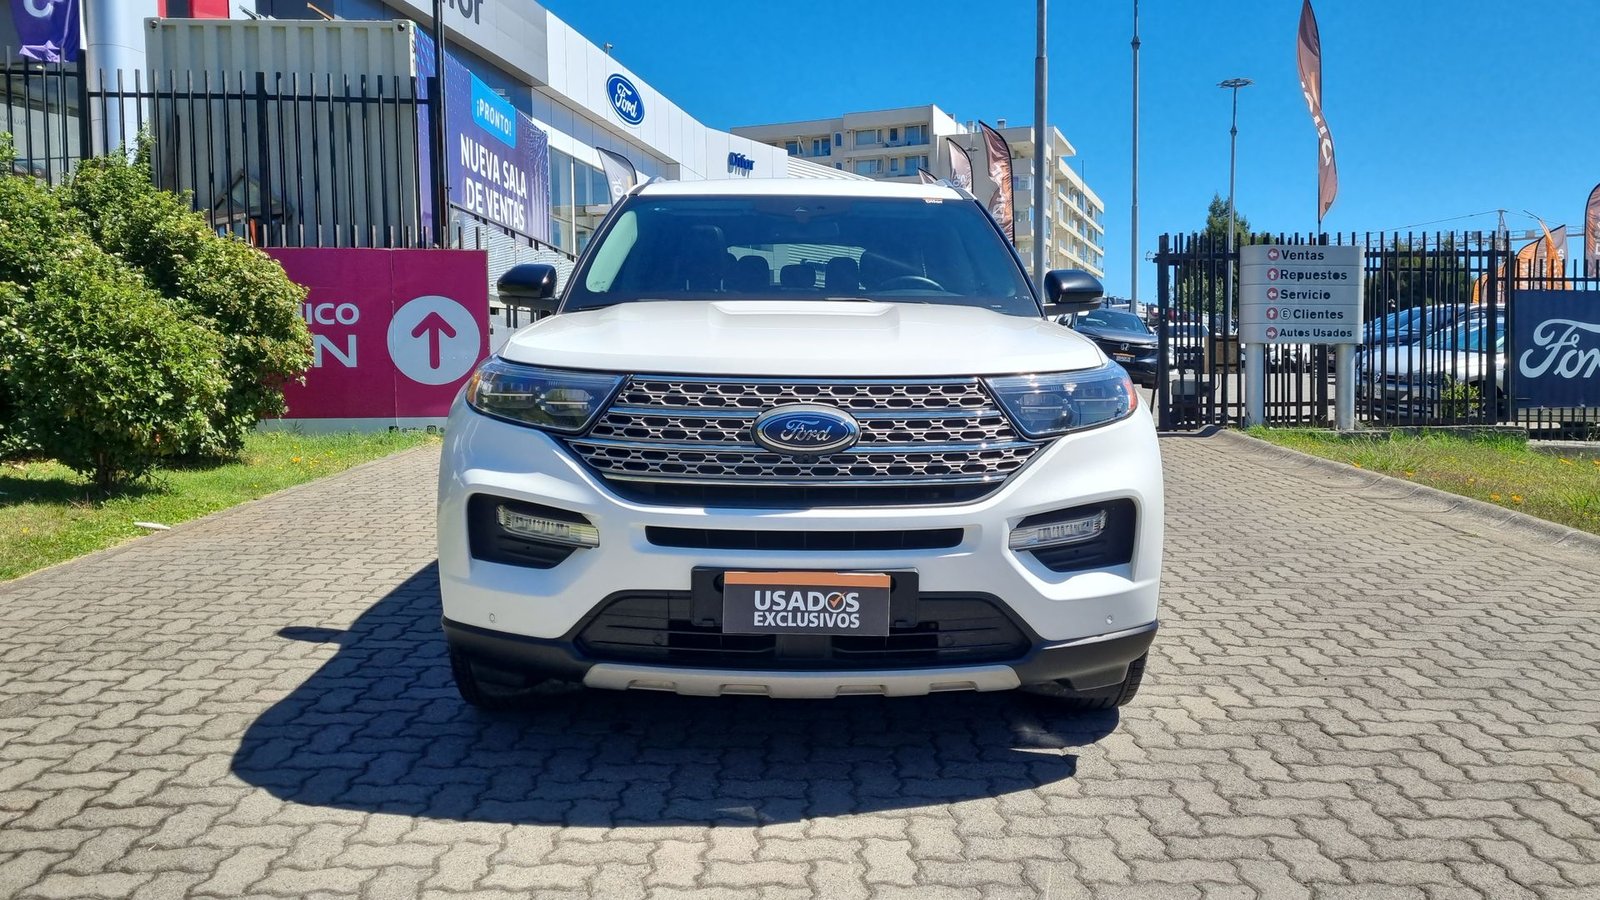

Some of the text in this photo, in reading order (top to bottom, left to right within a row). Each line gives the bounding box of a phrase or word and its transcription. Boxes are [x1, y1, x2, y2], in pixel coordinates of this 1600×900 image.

[614, 82, 638, 119] Ford
[476, 98, 512, 137] ¡PRONTO!
[460, 133, 528, 200] NUEVA SALA
[465, 177, 526, 232] DE VENTAS
[1281, 249, 1325, 260] Ventas
[1280, 269, 1348, 282] Repuestos
[1280, 289, 1331, 300] Servicio
[1293, 309, 1344, 319] Clientes
[1279, 328, 1353, 338] Autos Usados
[780, 419, 832, 442] Ford
[754, 590, 861, 613] USADOS
[753, 611, 861, 629] EXCLUSIVOS
